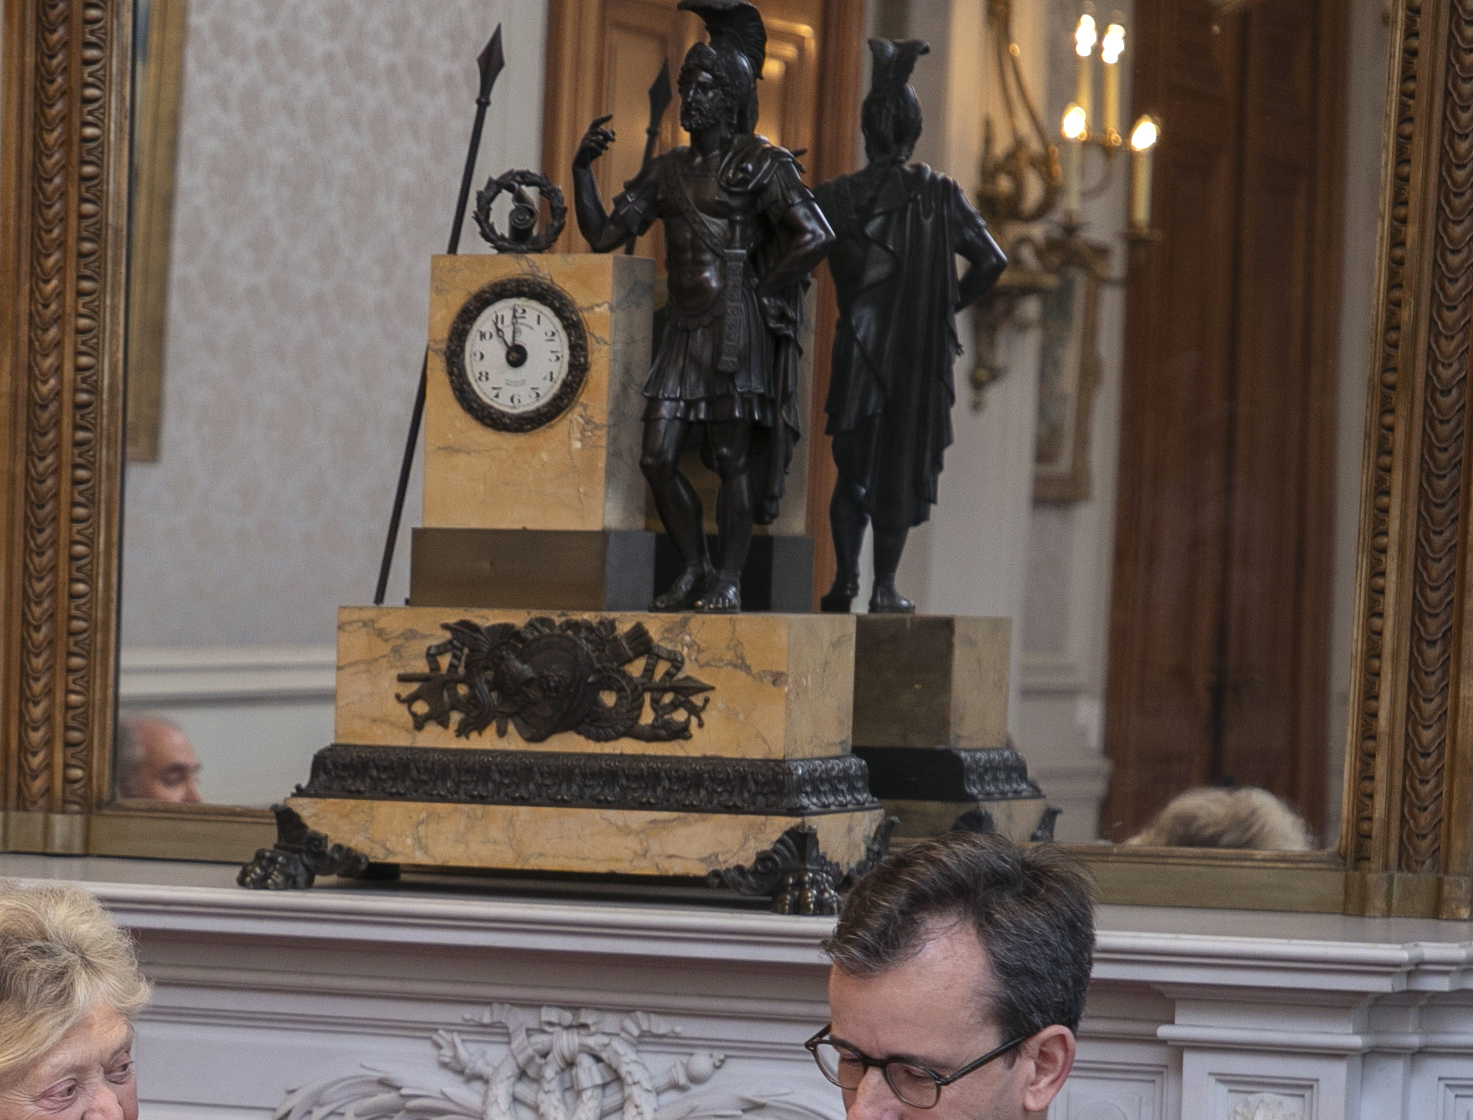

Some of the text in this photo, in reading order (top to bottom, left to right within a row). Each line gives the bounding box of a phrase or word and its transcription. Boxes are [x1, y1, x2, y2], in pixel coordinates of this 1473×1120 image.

[479, 331, 493, 341] 10
[545, 330, 556, 341] 2
[473, 351, 484, 362] 9
[549, 350, 560, 362] 3
[478, 371, 489, 382] 8
[543, 371, 554, 382] 4
[492, 386, 502, 399] 7
[529, 387, 540, 398] 5
[510, 393, 521, 404] 6
